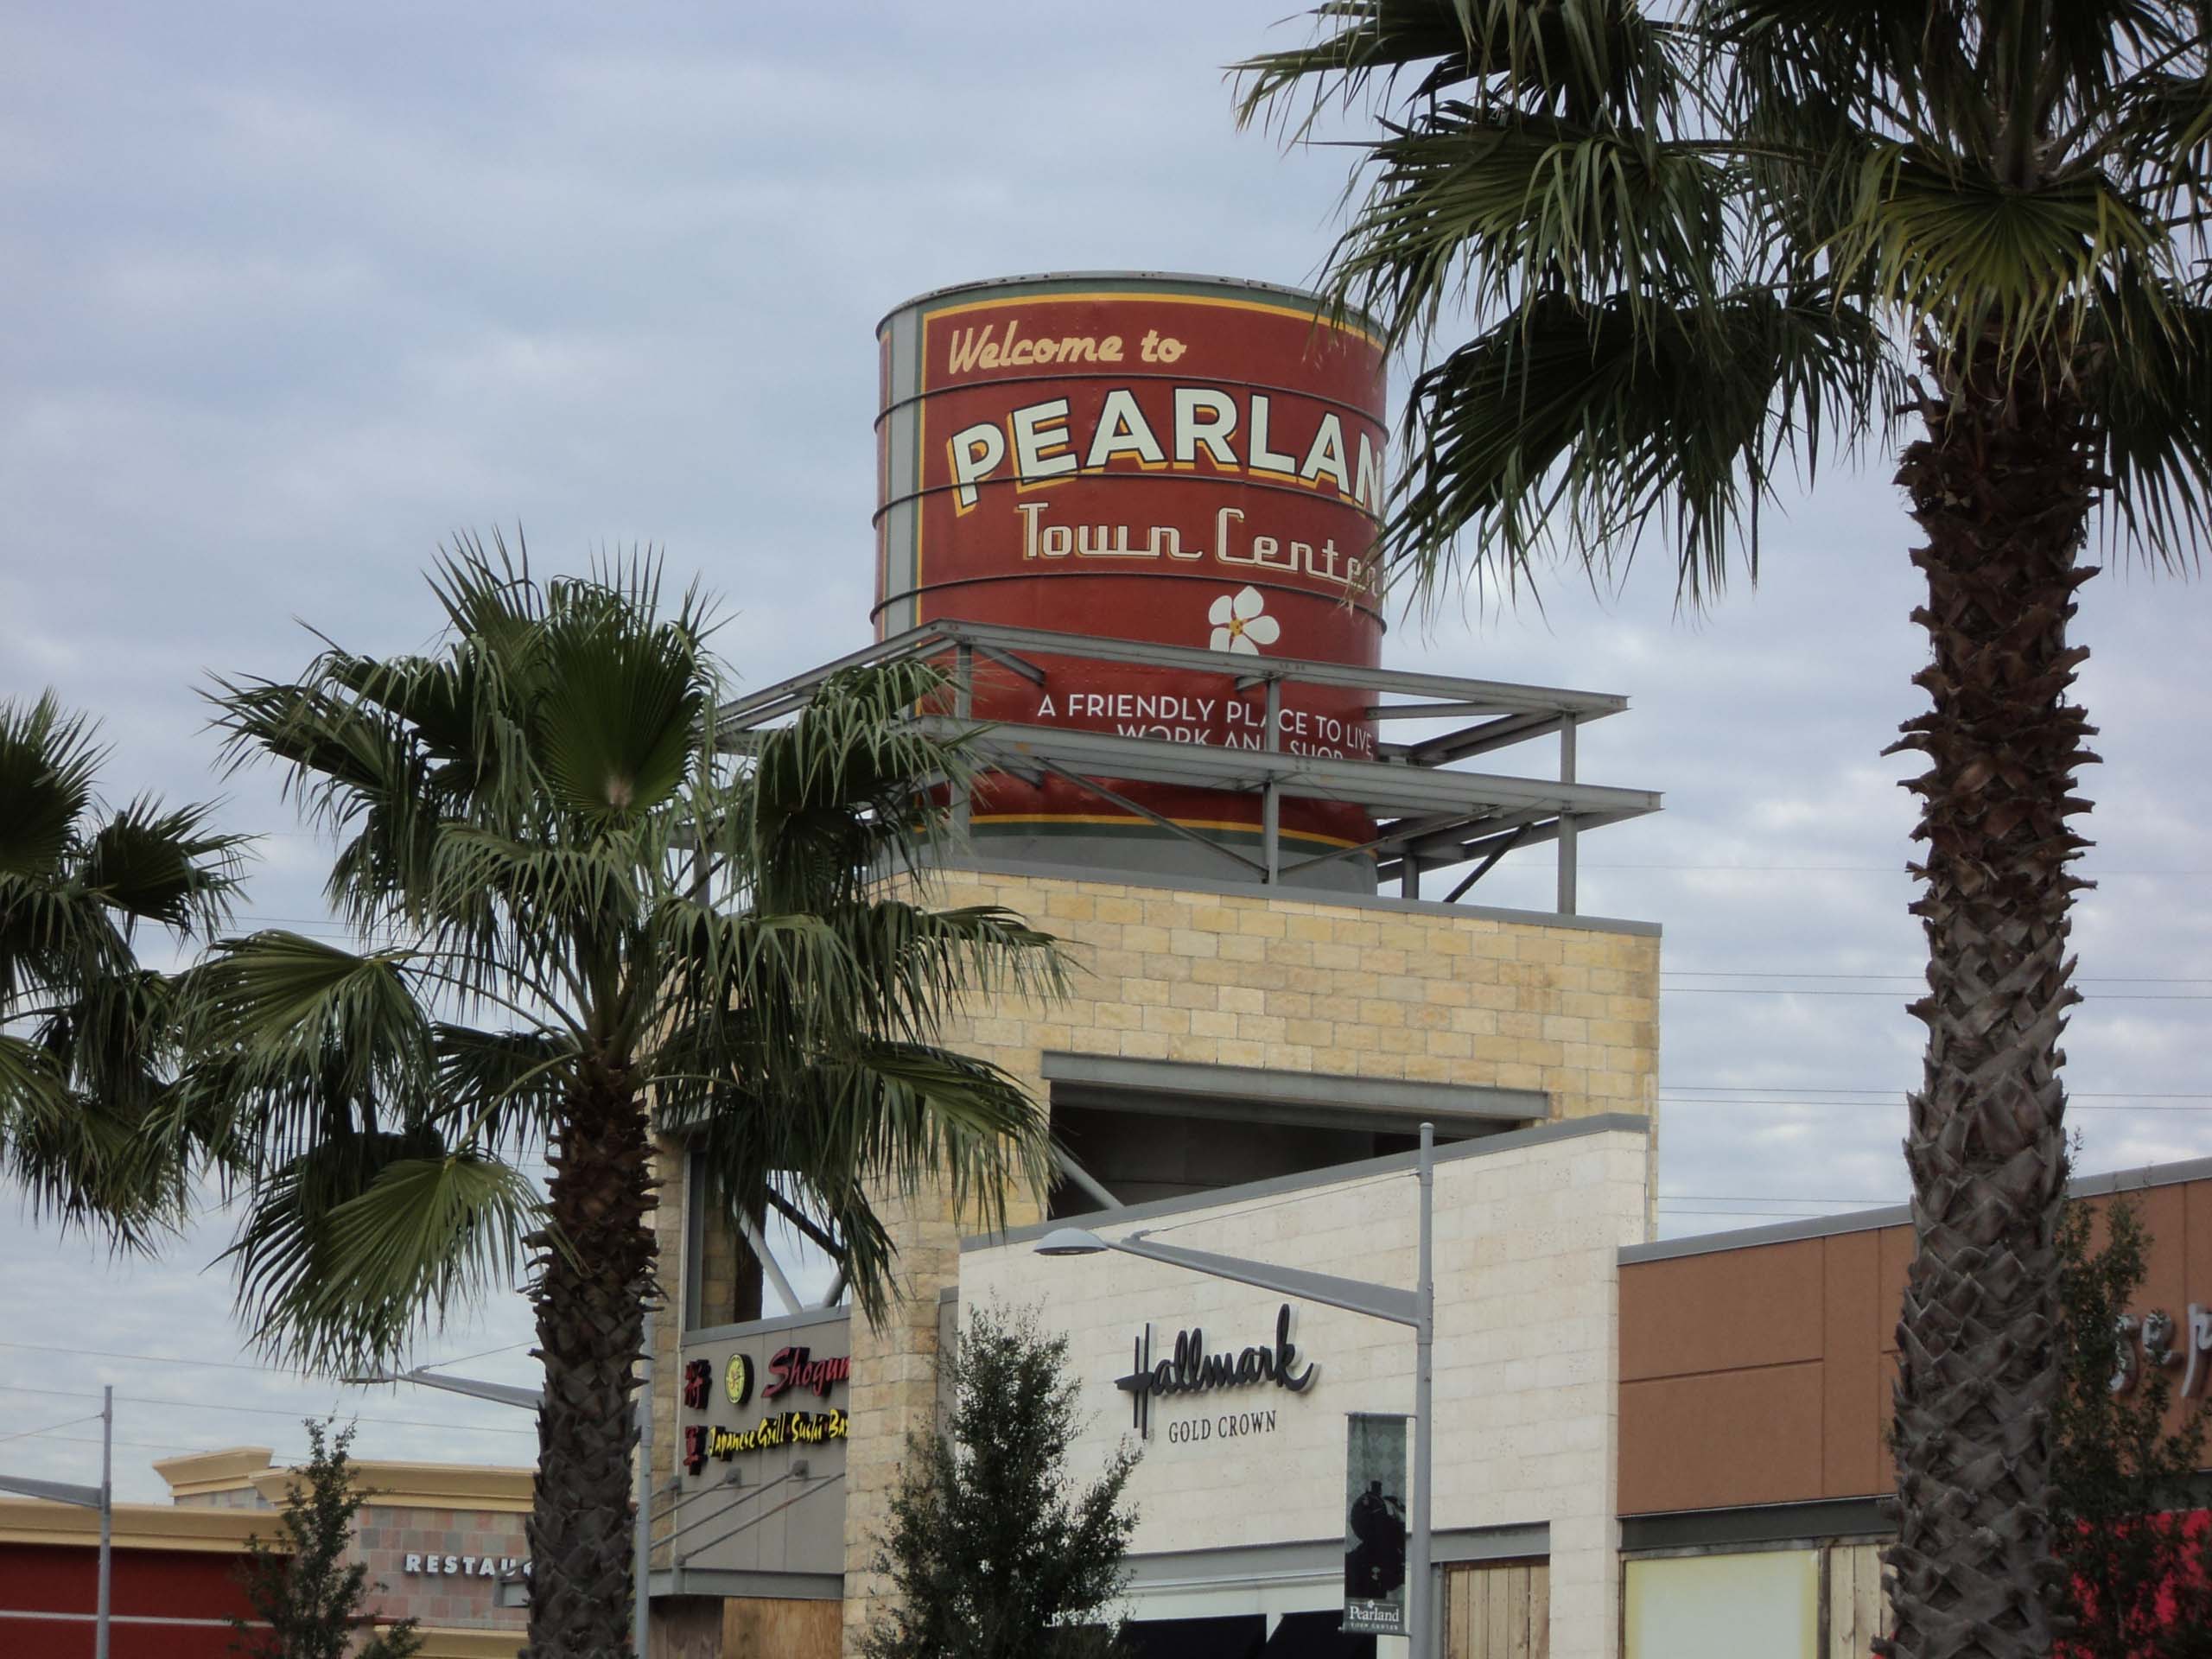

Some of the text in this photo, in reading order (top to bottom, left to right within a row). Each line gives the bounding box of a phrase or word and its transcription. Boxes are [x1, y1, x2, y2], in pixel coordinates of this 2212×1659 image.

[949, 320, 1187, 375] Welcome to
[1015, 502, 1204, 560] Town
[1037, 694, 1056, 717] A
[1068, 694, 1216, 723] FRIENDLY
[1314, 715, 1341, 742] TO
[1114, 1303, 1318, 1440] Hallmark
[709, 1426, 755, 1459] Japanese
[757, 1412, 785, 1449] Grill
[791, 1412, 823, 1444] Sushi
[1169, 1409, 1277, 1444] GOLD CROWN
[405, 1554, 532, 1576] RESTAU
[1349, 1605, 1399, 1623] Pearland
